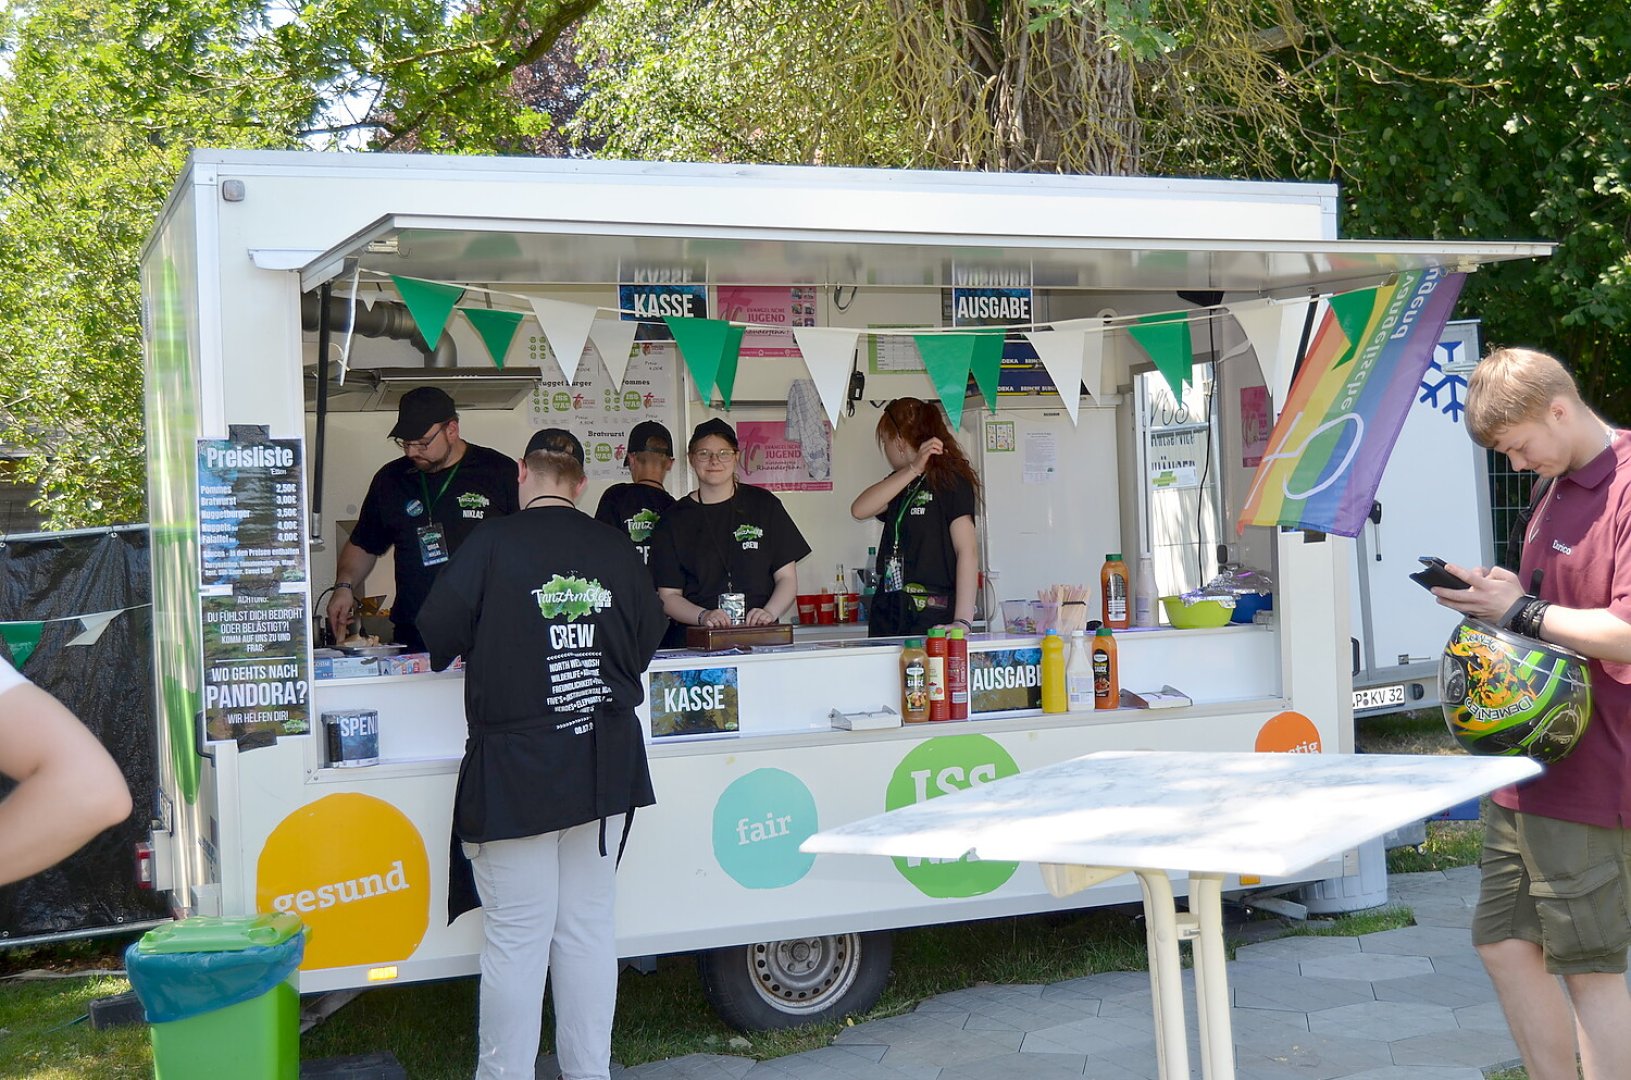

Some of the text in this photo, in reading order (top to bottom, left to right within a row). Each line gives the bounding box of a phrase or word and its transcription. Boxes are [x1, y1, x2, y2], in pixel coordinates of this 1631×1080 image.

[634, 294, 694, 318] KASSE
[957, 296, 1029, 319] AUSGABE
[748, 314, 785, 322] JUGEND
[207, 446, 294, 468] Preisliste
[765, 450, 801, 458] JUGEND
[200, 484, 296, 494] Pommes 2,50€
[201, 496, 297, 506] Bratwurst 3,00€
[201, 508, 297, 519] Nuggetburger 3,50€
[462, 510, 484, 519] NIKLAS
[910, 507, 925, 515] CREW
[277, 521, 298, 530] 4,00€
[278, 532, 298, 542] 4,00€
[742, 541, 758, 550] CREW
[249, 548, 271, 556] Preisen
[208, 608, 303, 622] DU FÜHLST DICH BEDROHT
[221, 623, 240, 634] ODER
[222, 633, 290, 644] KOMM AUF UNS ZU UND
[550, 624, 595, 650] CREW
[247, 644, 264, 652] FRAG:
[212, 664, 298, 682] WO GEHTS NACH
[206, 680, 308, 708] PANDORA?
[664, 684, 725, 712] KASSE
[1370, 690, 1385, 704] KV
[1389, 688, 1403, 702] 32
[227, 710, 288, 724] WIR HELFEN DIR!
[736, 814, 792, 845] fair
[273, 860, 410, 916] gesund
